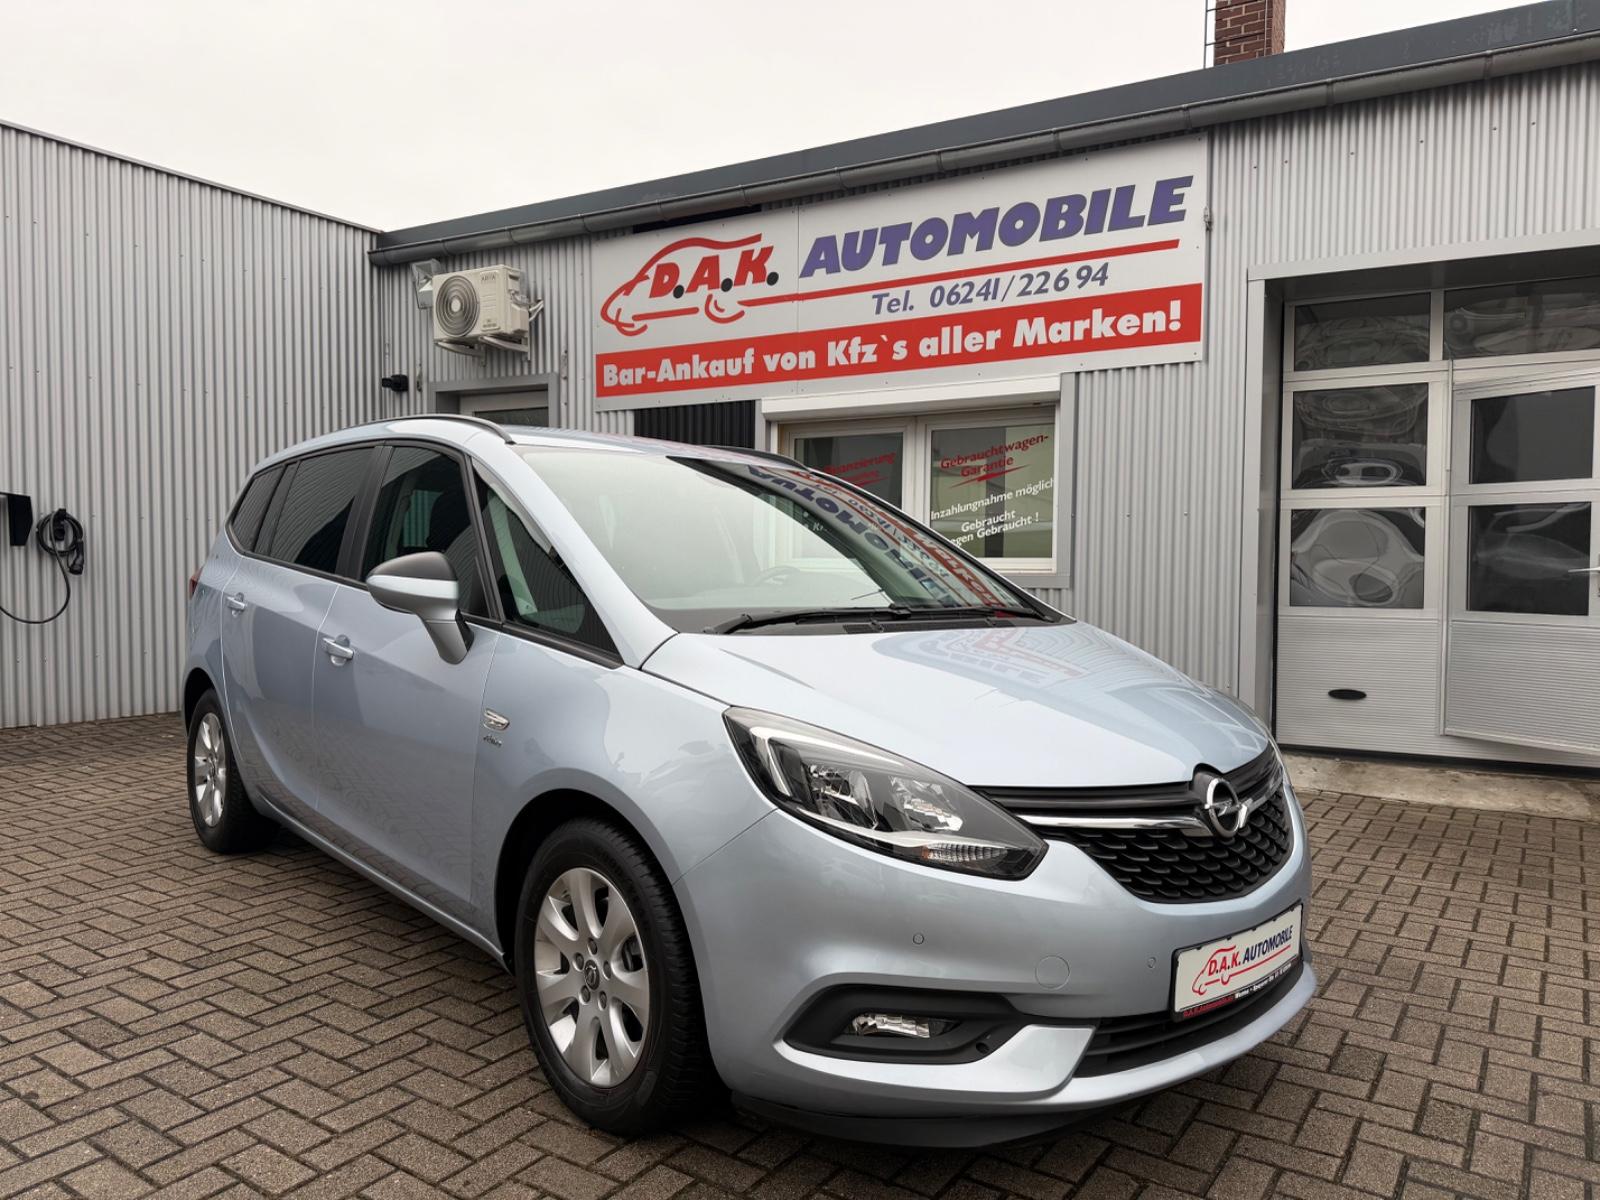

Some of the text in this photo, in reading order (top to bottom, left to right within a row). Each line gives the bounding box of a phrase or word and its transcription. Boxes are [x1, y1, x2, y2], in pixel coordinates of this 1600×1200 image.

[649, 175, 1194, 299] D.A.K. AUTOMOBILE
[872, 289, 915, 315] Tel.
[603, 348, 755, 388] Bar-Ankauf
[763, 349, 816, 373] von
[919, 325, 1002, 358] aller
[1013, 300, 1181, 348] Marken!
[941, 433, 1049, 470] Gebrauchtwagen-
[960, 456, 1014, 477] Garantie
[930, 491, 1013, 520] Inzahlungnahme
[961, 509, 1016, 532] Gebraucht
[976, 515, 1033, 539] Gebraucht
[1208, 925, 1293, 976] D.A.K. AUTOMOBILE
